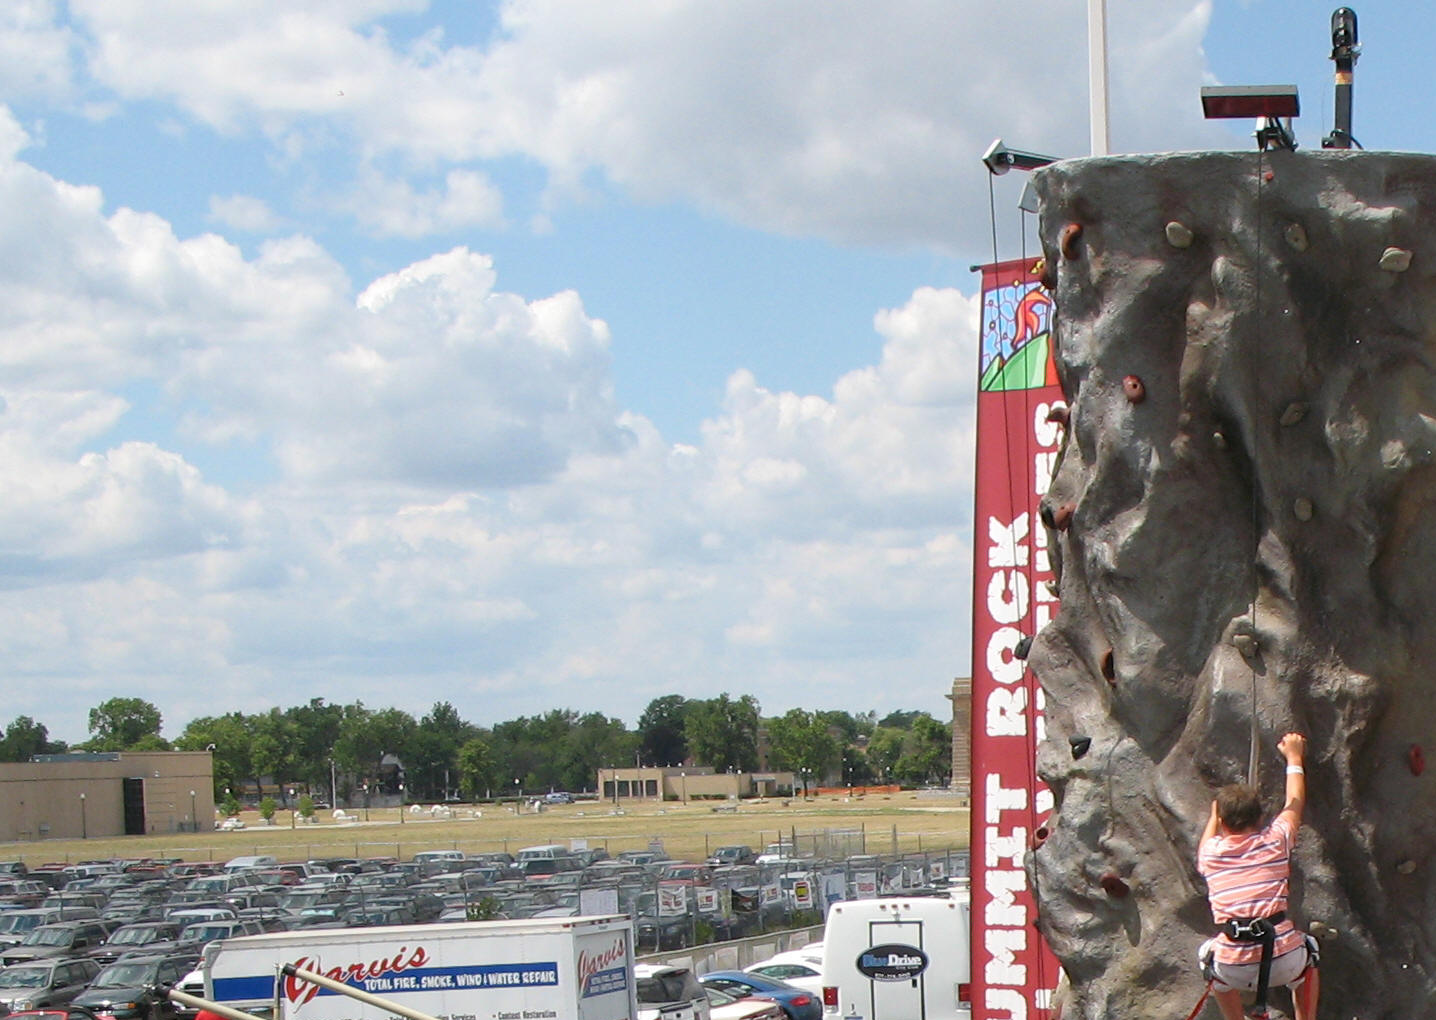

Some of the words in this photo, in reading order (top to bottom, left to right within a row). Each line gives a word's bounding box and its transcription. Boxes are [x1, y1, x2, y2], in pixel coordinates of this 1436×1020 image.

[985, 511, 1029, 737] ROCK
[285, 945, 430, 1014] Jarvis
[364, 978, 393, 991] TOTAL
[457, 974, 482, 987] WIND
[488, 972, 521, 986] WATER
[522, 970, 556, 983] REPAIR
